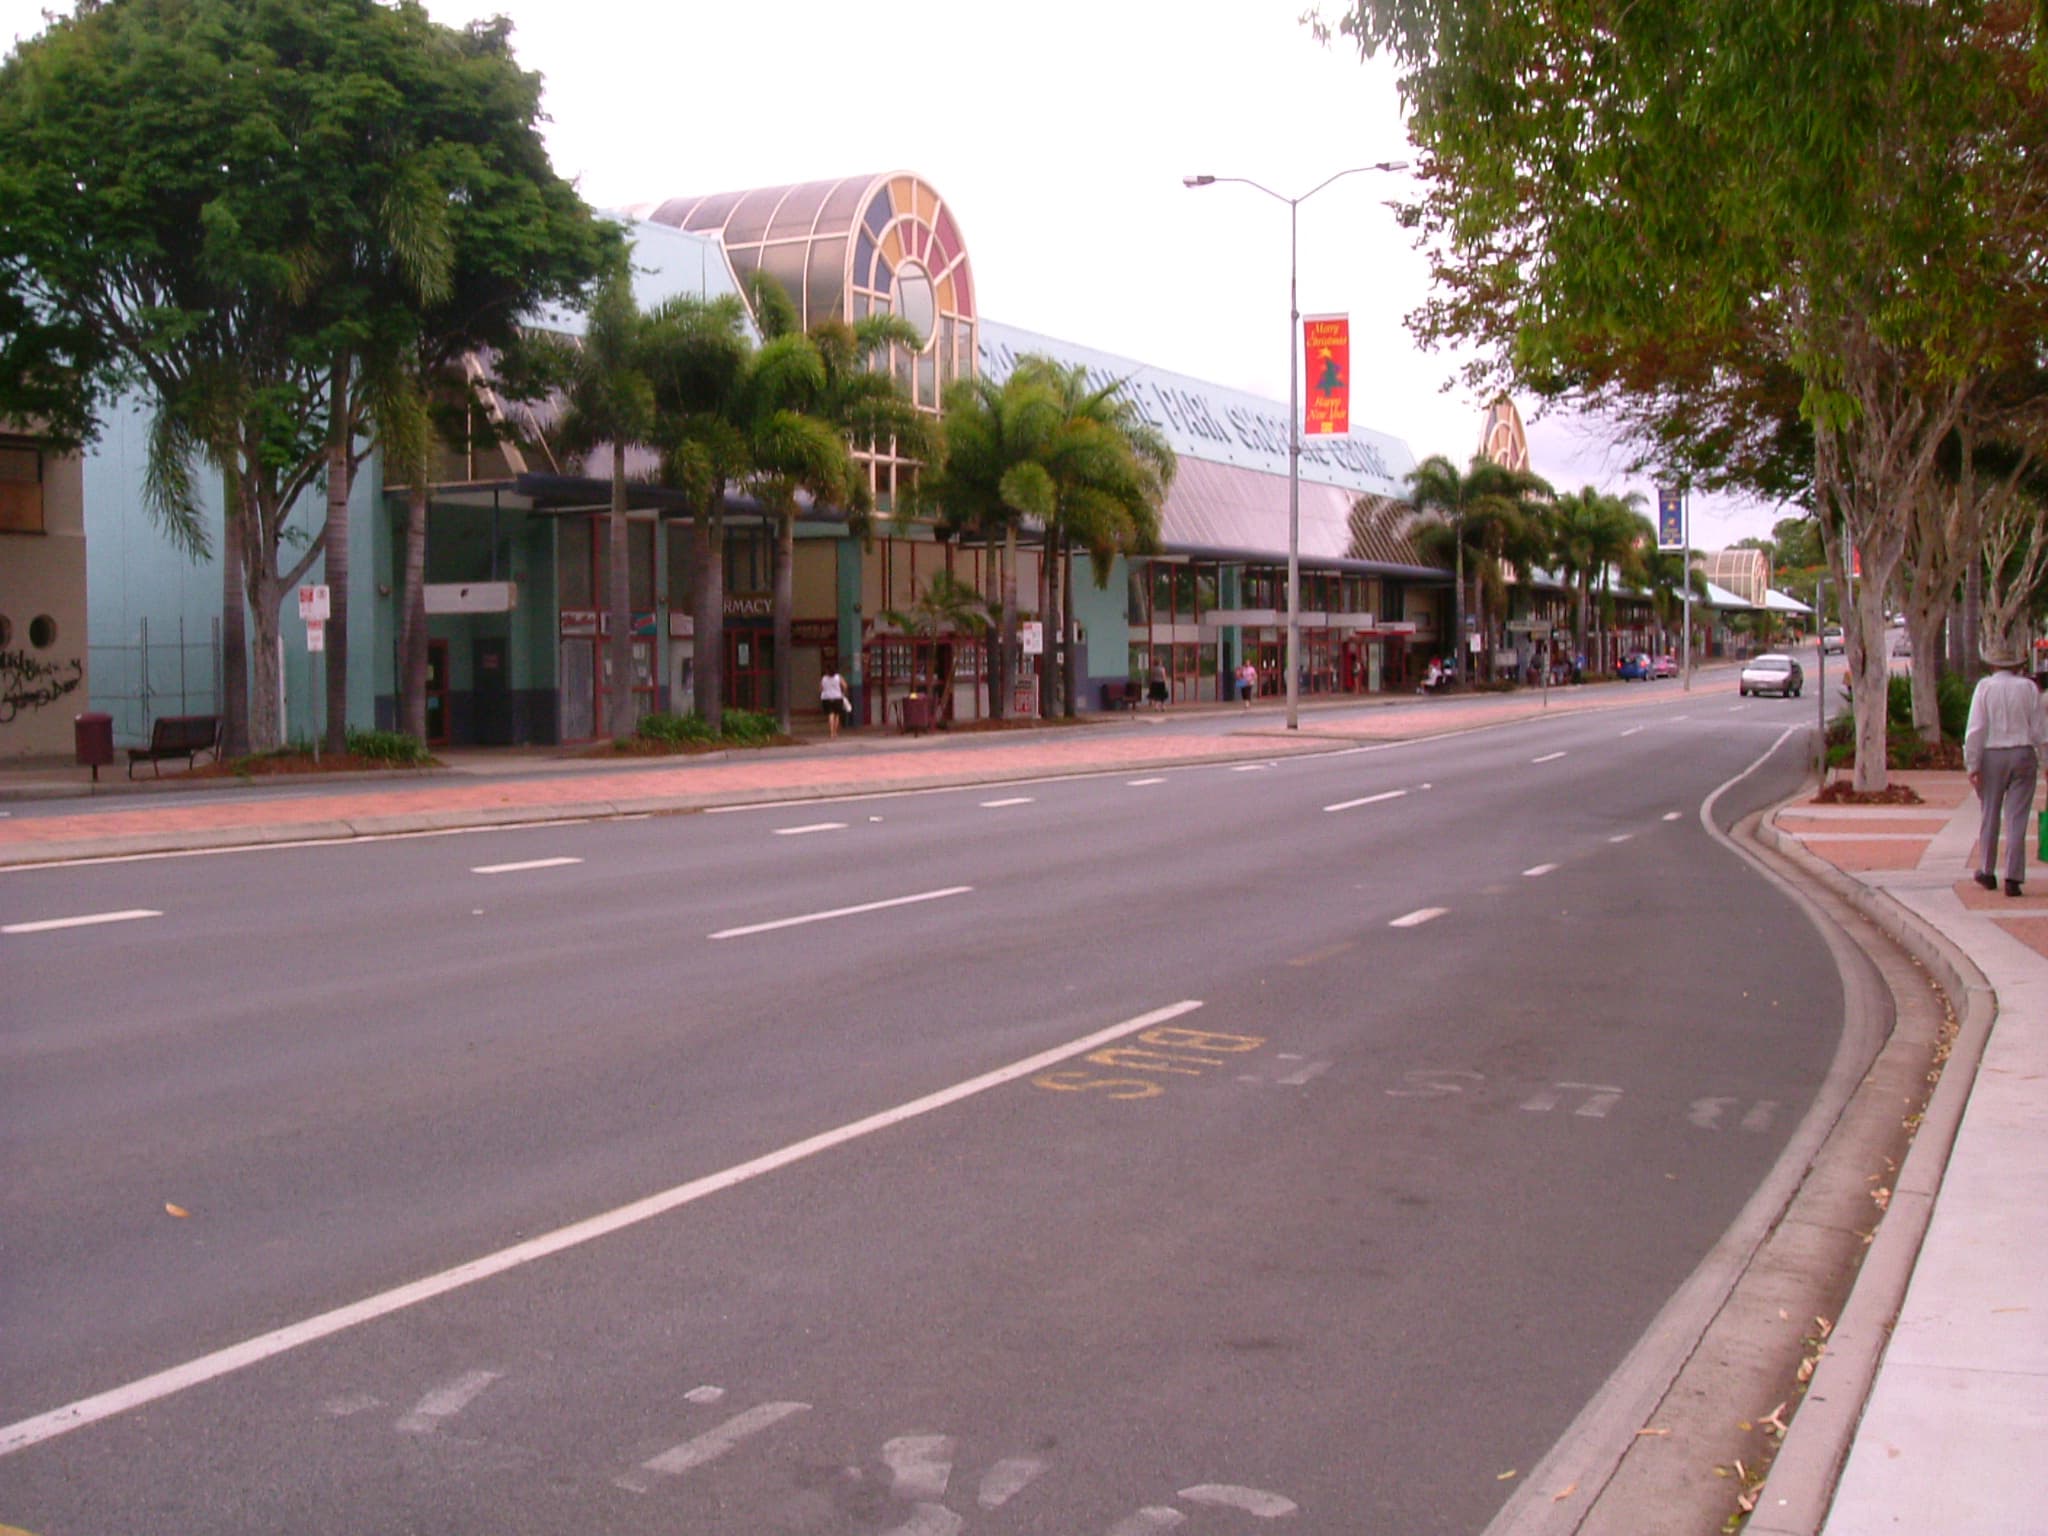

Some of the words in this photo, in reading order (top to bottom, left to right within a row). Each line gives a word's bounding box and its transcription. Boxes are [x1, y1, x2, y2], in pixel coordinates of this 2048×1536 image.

[1313, 322, 1340, 335] Merry
[1314, 396, 1343, 409] Happy
[722, 598, 773, 615] RMACY
[1031, 1026, 1267, 1101] BUS
